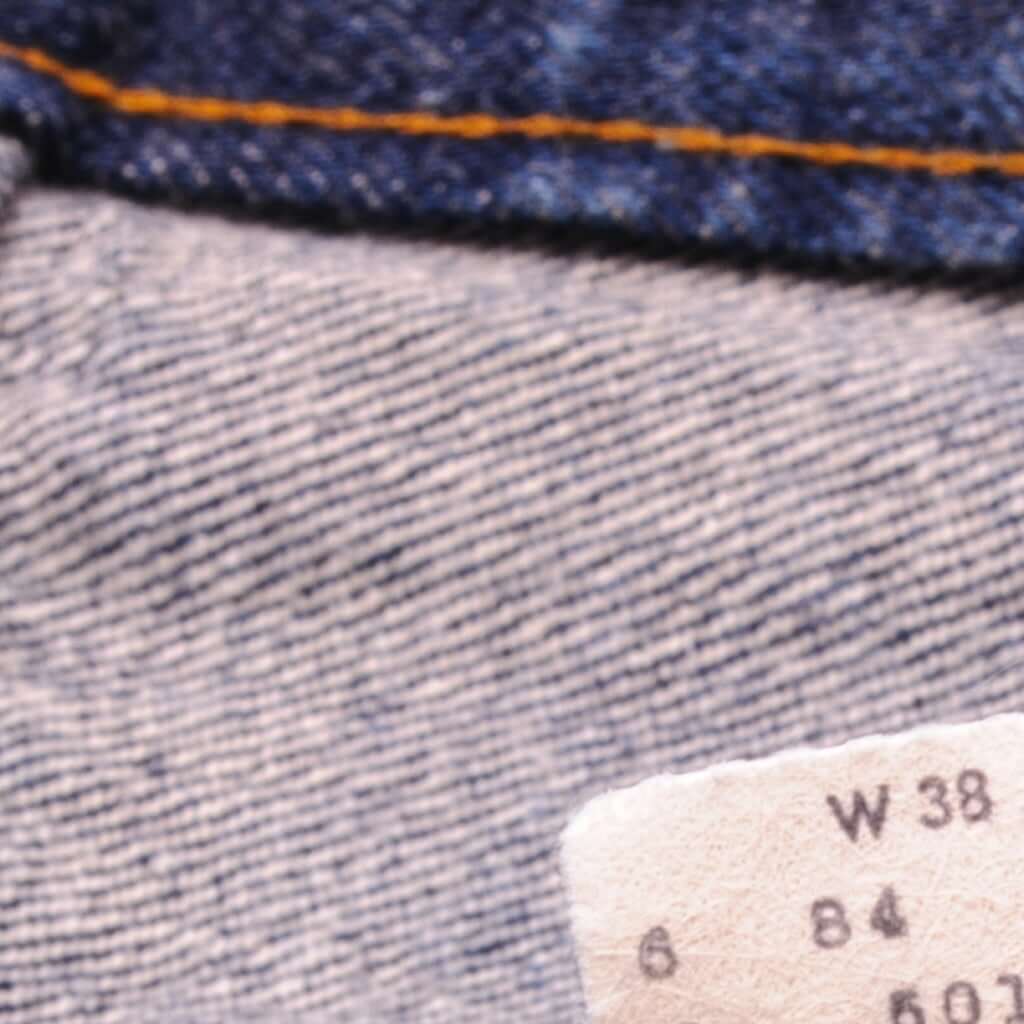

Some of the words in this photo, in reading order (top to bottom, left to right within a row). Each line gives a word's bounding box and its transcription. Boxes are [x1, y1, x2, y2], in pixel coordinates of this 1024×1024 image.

[826, 784, 890, 842] W
[917, 768, 994, 828] 38
[810, 885, 908, 949] 84
